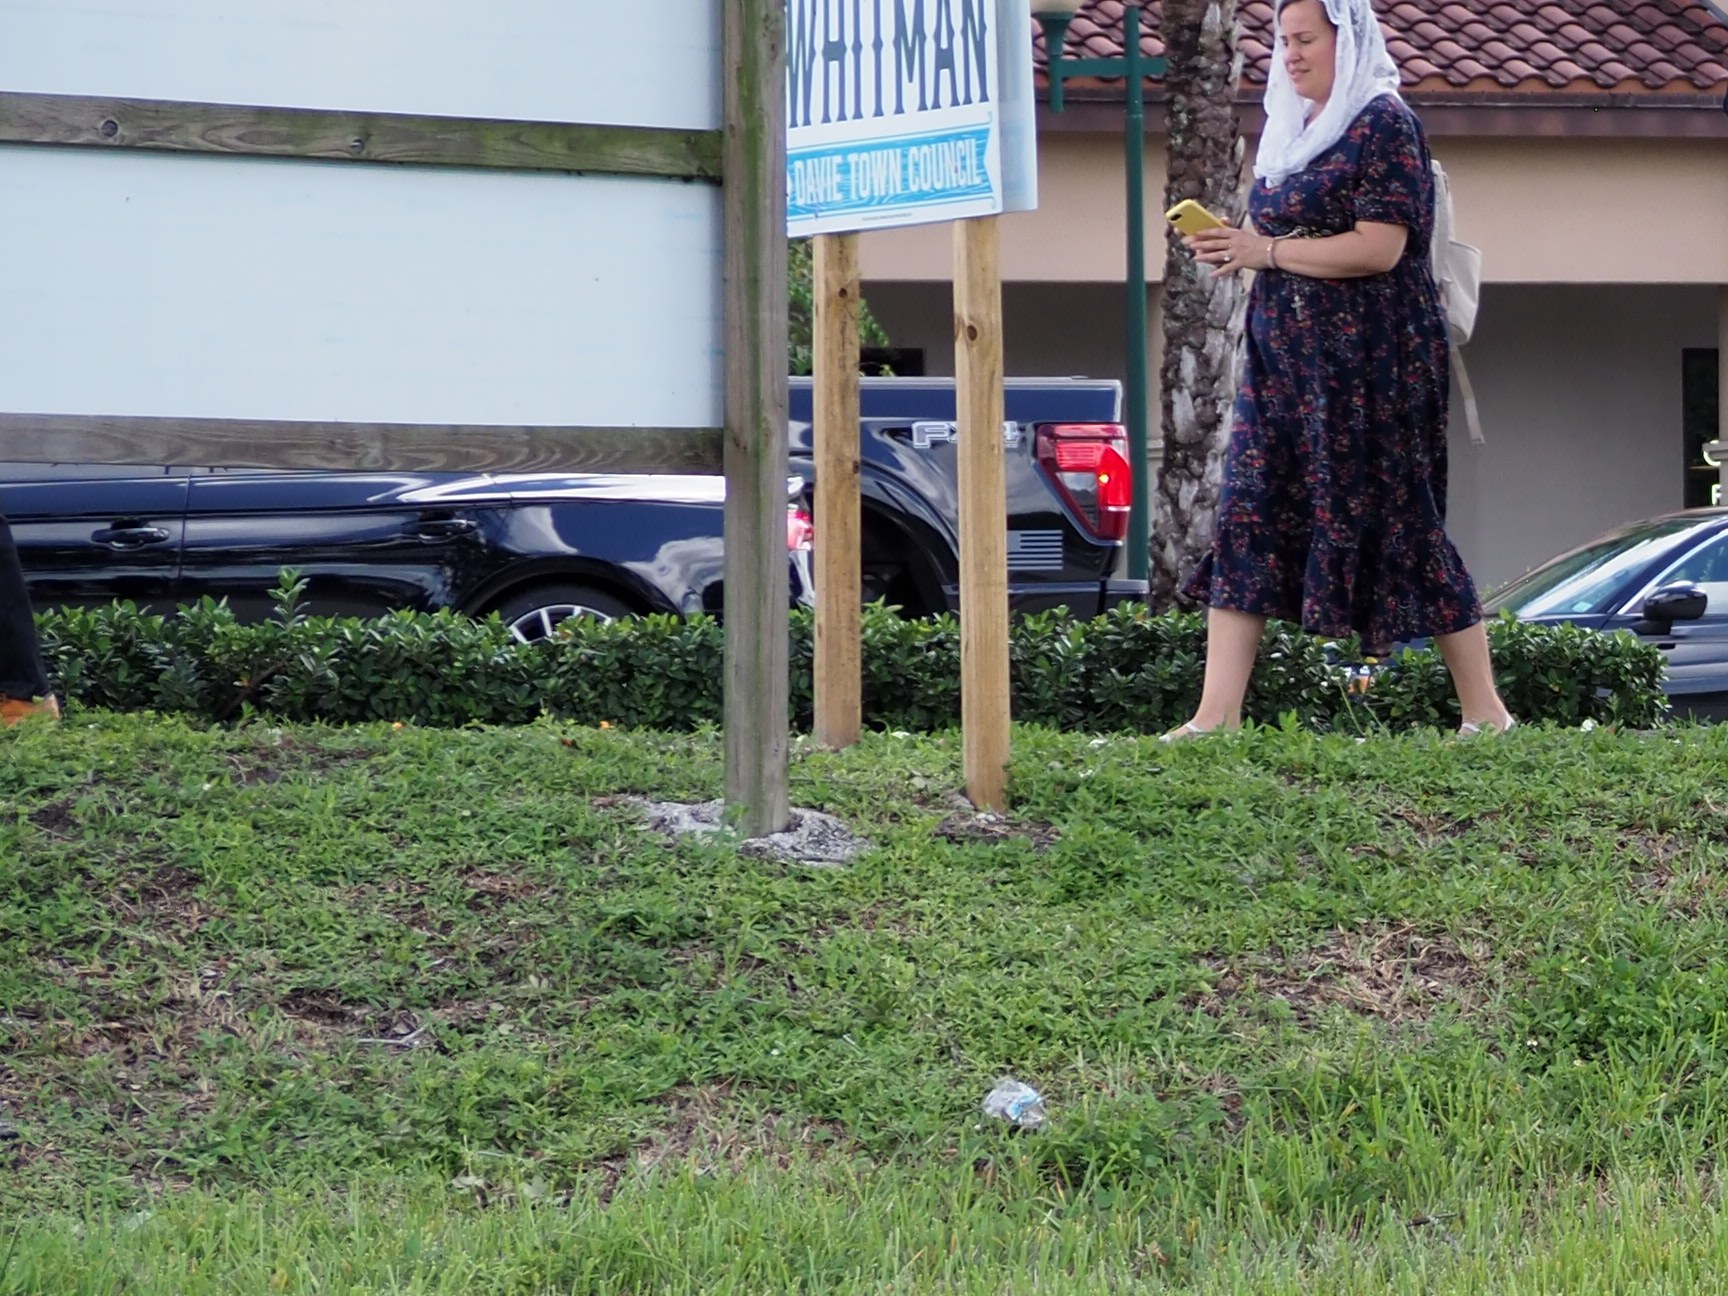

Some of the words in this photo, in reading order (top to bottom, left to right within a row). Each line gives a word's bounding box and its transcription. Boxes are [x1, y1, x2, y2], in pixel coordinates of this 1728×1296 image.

[794, 155, 843, 206] DAVIE
[848, 148, 901, 201] TOWN
[908, 138, 981, 192] COUNCIL
